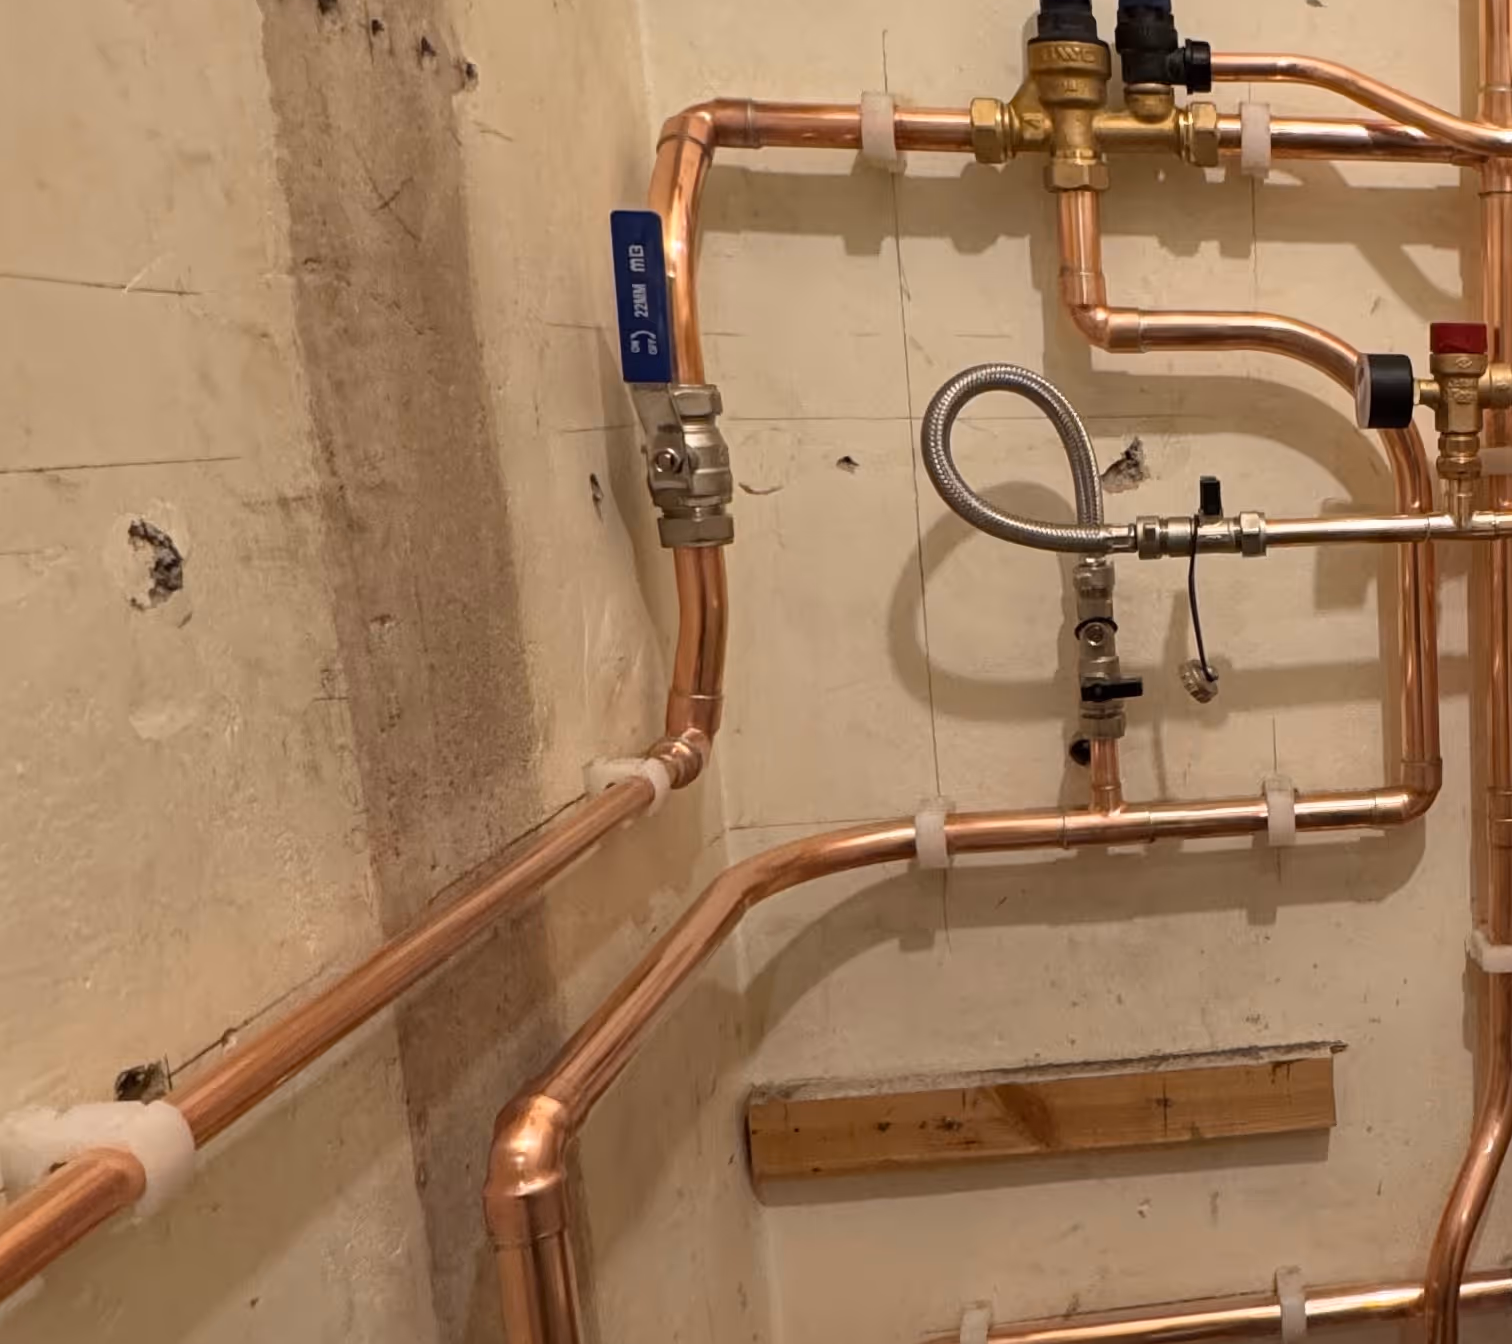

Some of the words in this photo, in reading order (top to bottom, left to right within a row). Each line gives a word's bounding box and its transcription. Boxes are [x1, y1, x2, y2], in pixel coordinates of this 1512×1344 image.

[632, 283, 649, 318] 22MM
[630, 339, 641, 354] ON
[647, 338, 659, 356] OFF
